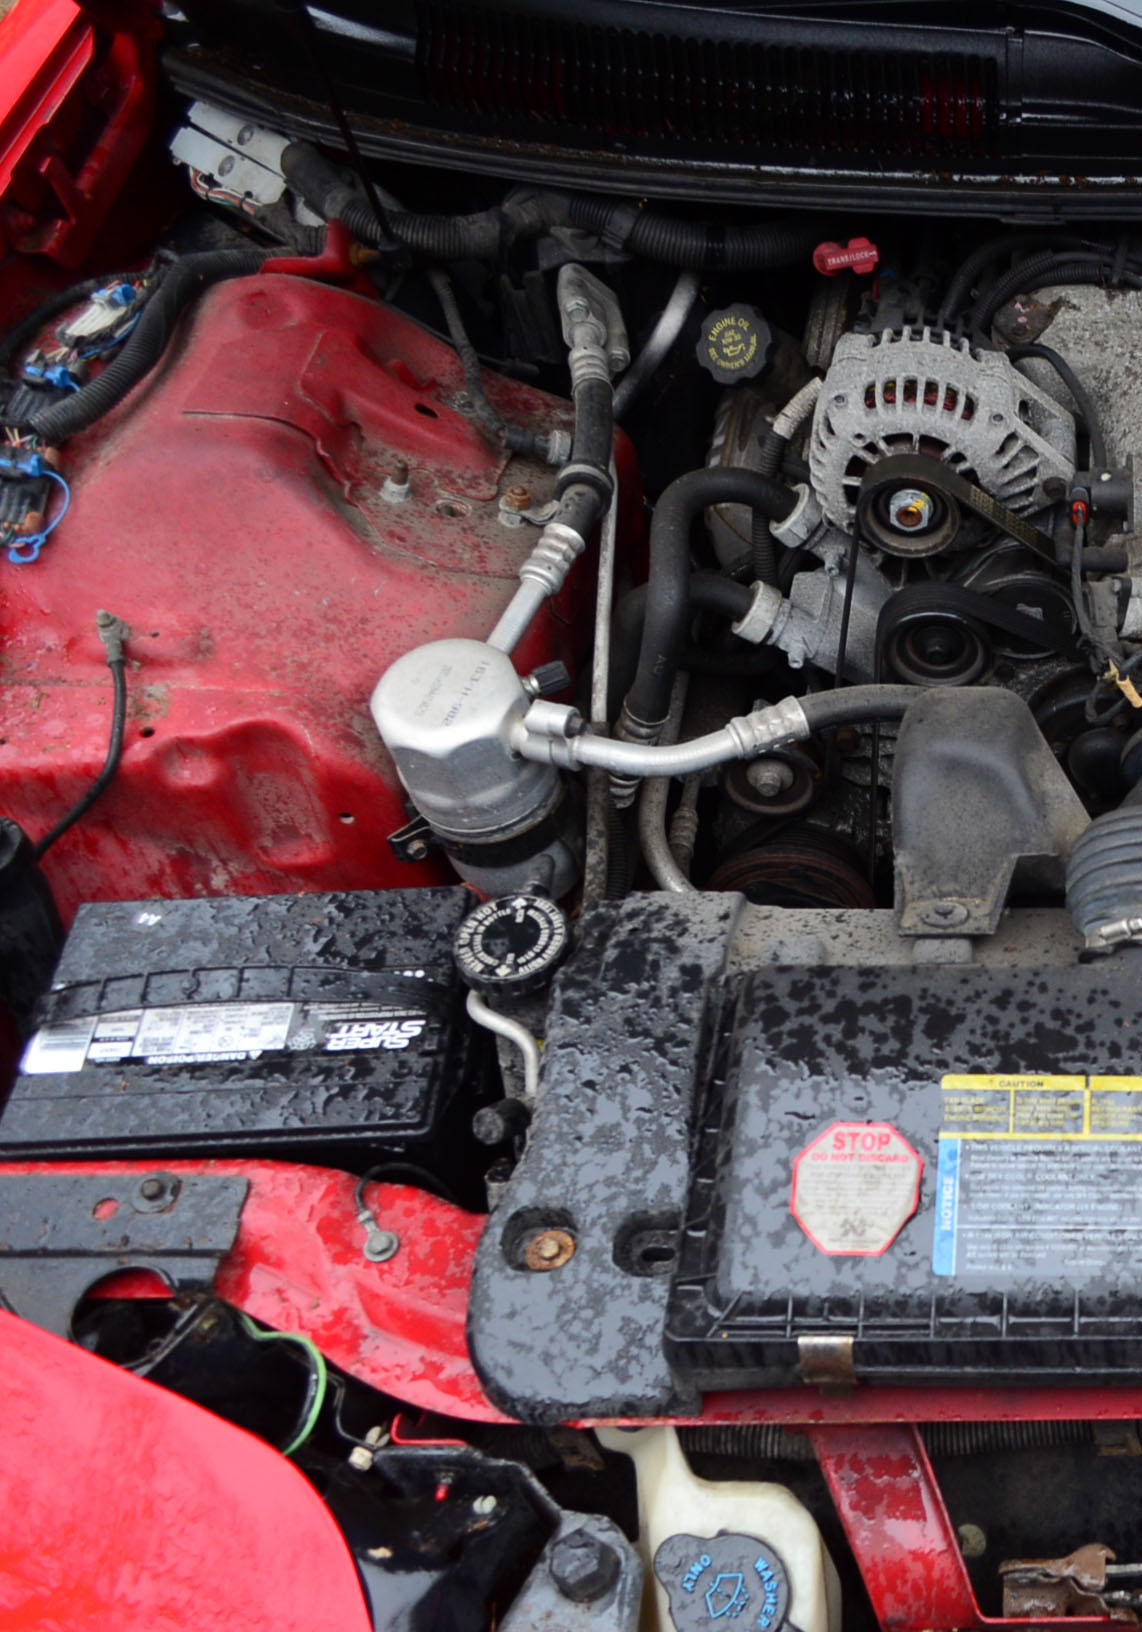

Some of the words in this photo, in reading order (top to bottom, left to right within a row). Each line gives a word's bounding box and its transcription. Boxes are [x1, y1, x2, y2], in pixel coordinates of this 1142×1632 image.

[708, 316, 736, 341] ENGINE
[738, 318, 750, 332] OIL
[474, 902, 497, 921] HOT
[458, 920, 479, 945] OPEN
[458, 946, 485, 973] NEVER
[336, 1019, 426, 1038] START
[323, 1035, 410, 1051] SUPER
[833, 1131, 891, 1151] STOP
[990, 1143, 1022, 1151] VEHICLE
[811, 1153, 828, 1162] DO
[831, 1153, 855, 1162] NOT
[858, 1153, 909, 1163] DISCARD
[940, 1176, 954, 1231] NOTICE
[682, 1554, 712, 1593] ONLY
[754, 1556, 779, 1628] WASHER
